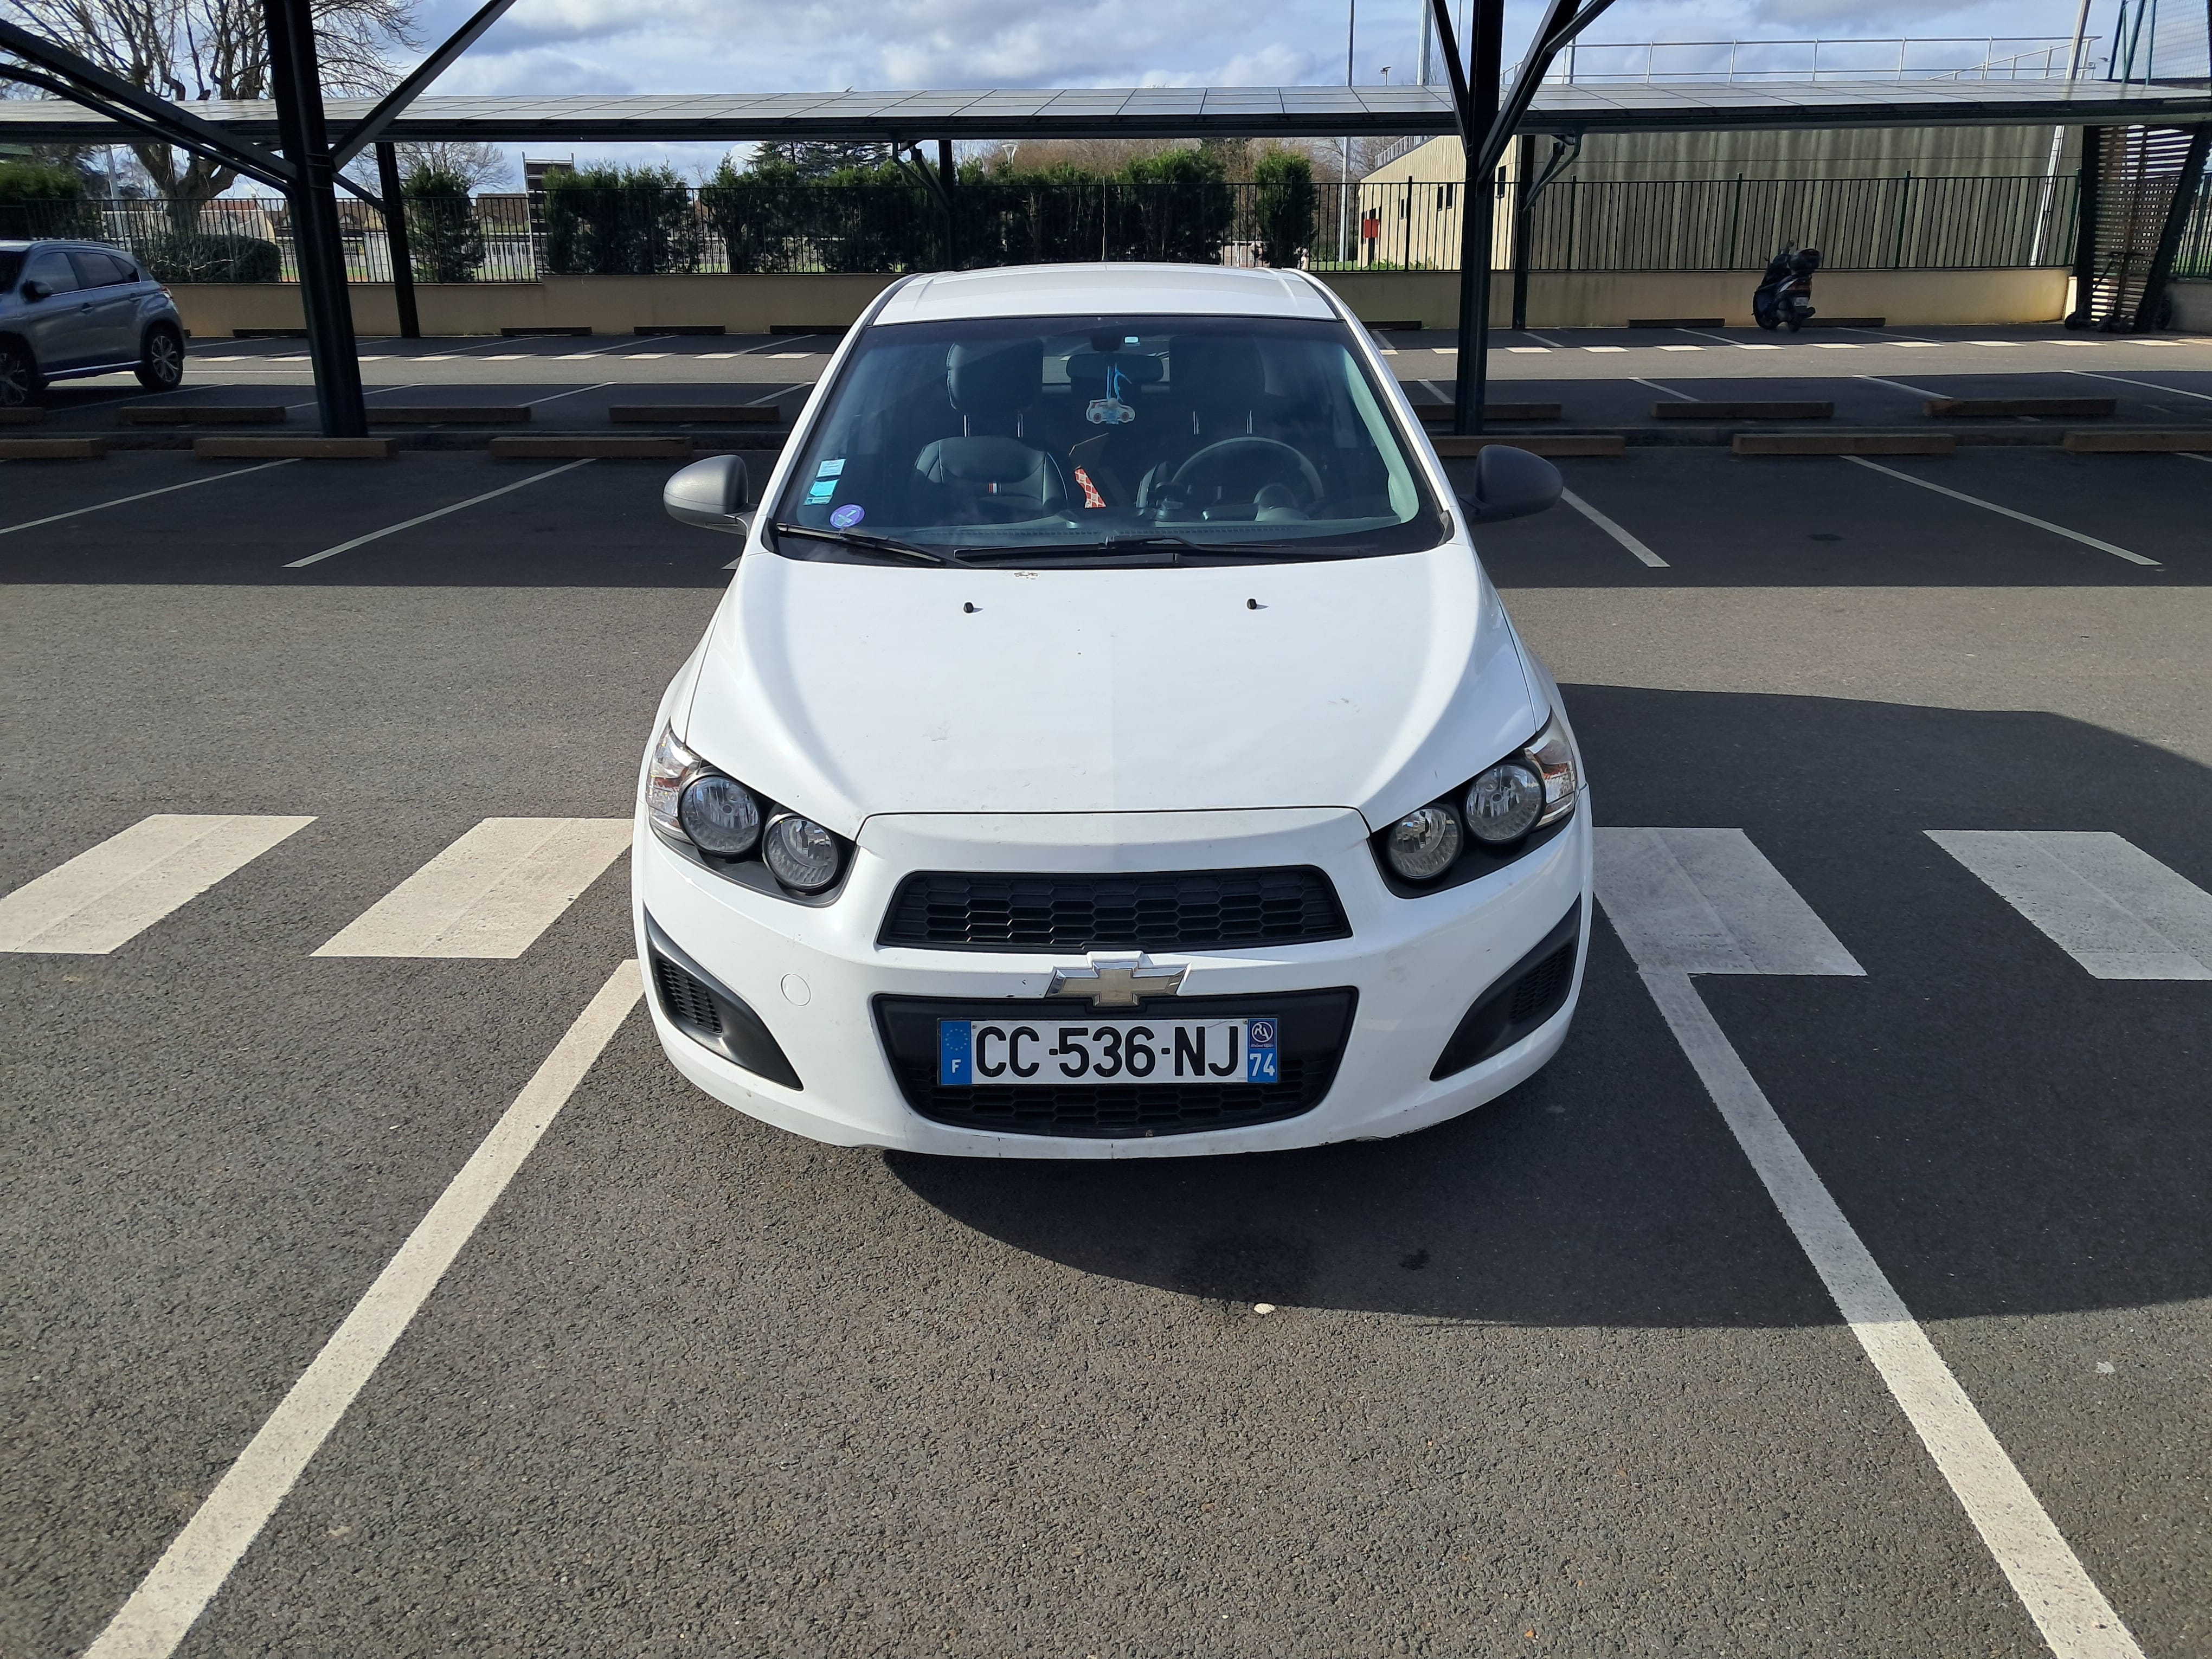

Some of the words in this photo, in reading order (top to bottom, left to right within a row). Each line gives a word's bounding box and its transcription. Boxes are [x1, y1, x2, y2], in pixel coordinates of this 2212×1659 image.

[952, 1059, 961, 1073] F
[976, 1026, 1238, 1078] CC-536-NJ
[1250, 1053, 1275, 1076] 74
